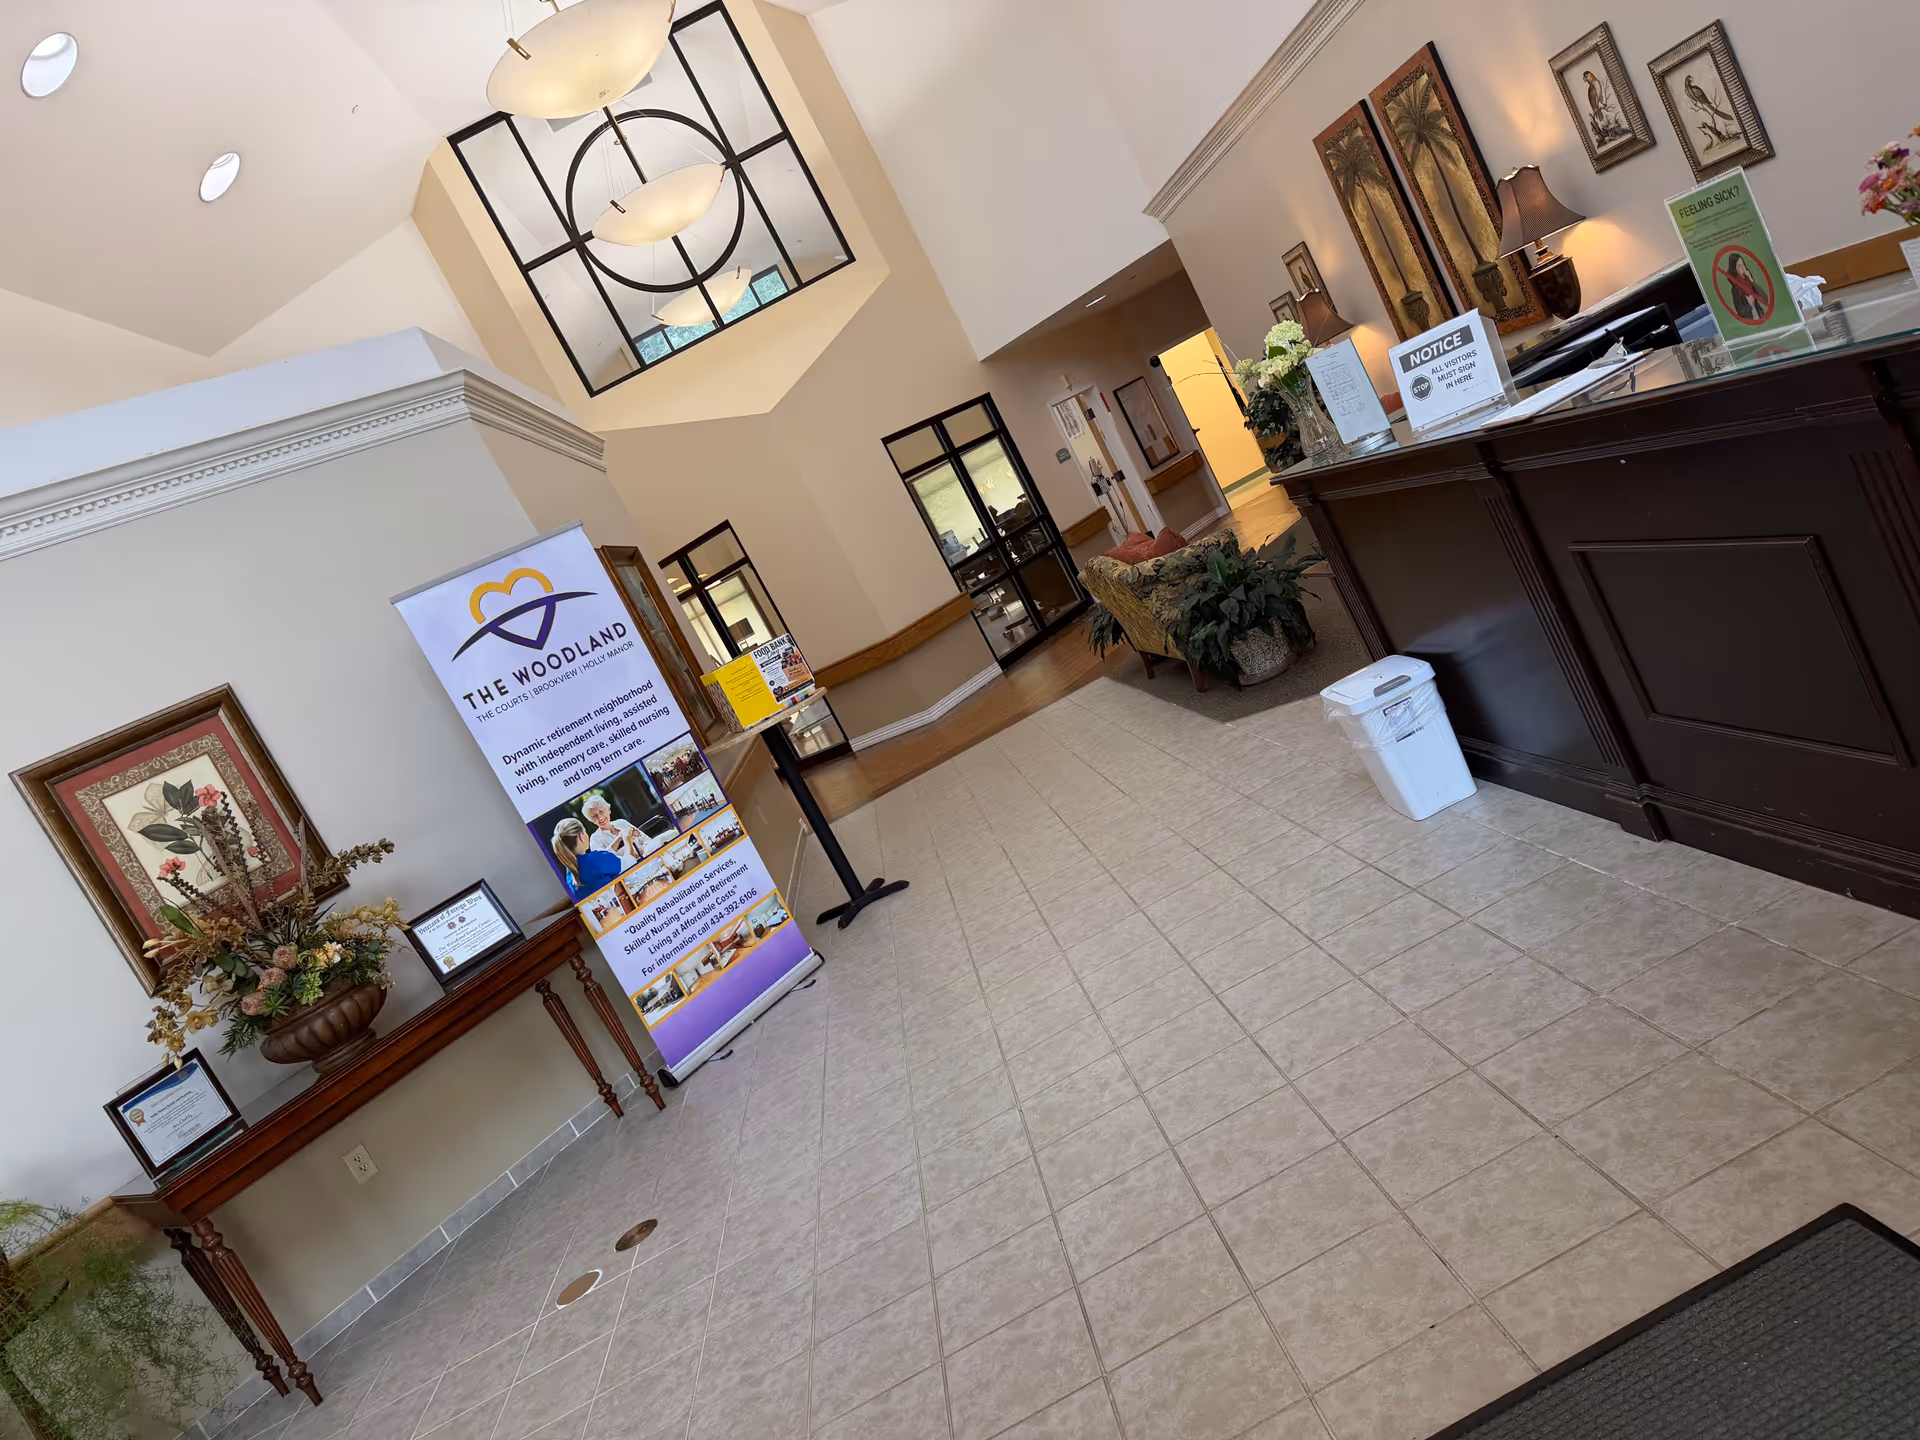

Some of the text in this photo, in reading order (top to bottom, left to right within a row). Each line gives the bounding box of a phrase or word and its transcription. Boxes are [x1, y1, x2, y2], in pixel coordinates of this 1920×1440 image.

[1679, 197, 1714, 218] FEELING
[1714, 185, 1740, 204] SICK?
[1410, 332, 1462, 367] NOTICE
[1431, 350, 1477, 375] ALL VISITORS
[1437, 361, 1476, 382] MUST SIGN
[1413, 382, 1429, 394] STOP
[1454, 373, 1474, 386] HERE
[463, 622, 627, 710] THE WOODLAND
[753, 637, 787, 659] FOOD BANK
[476, 640, 634, 723] THE COURTS BROOKVIEW HOLLY MANOR
[502, 680, 654, 765] Dynamic retirement neighborhood
[515, 694, 658, 777] with independent living, assisted
[516, 705, 670, 795] living, memory care, skilled nursing
[563, 740, 645, 788] and long term care.
[624, 863, 749, 955] Skilled Nursing Care and Retirement
[656, 878, 705, 916] Rehabilitation
[704, 858, 737, 882] Services,
[641, 887, 758, 977] For information call 434-392-6106
[648, 935, 673, 956] Living
[672, 927, 682, 936] at
[681, 902, 716, 932] Affordable
